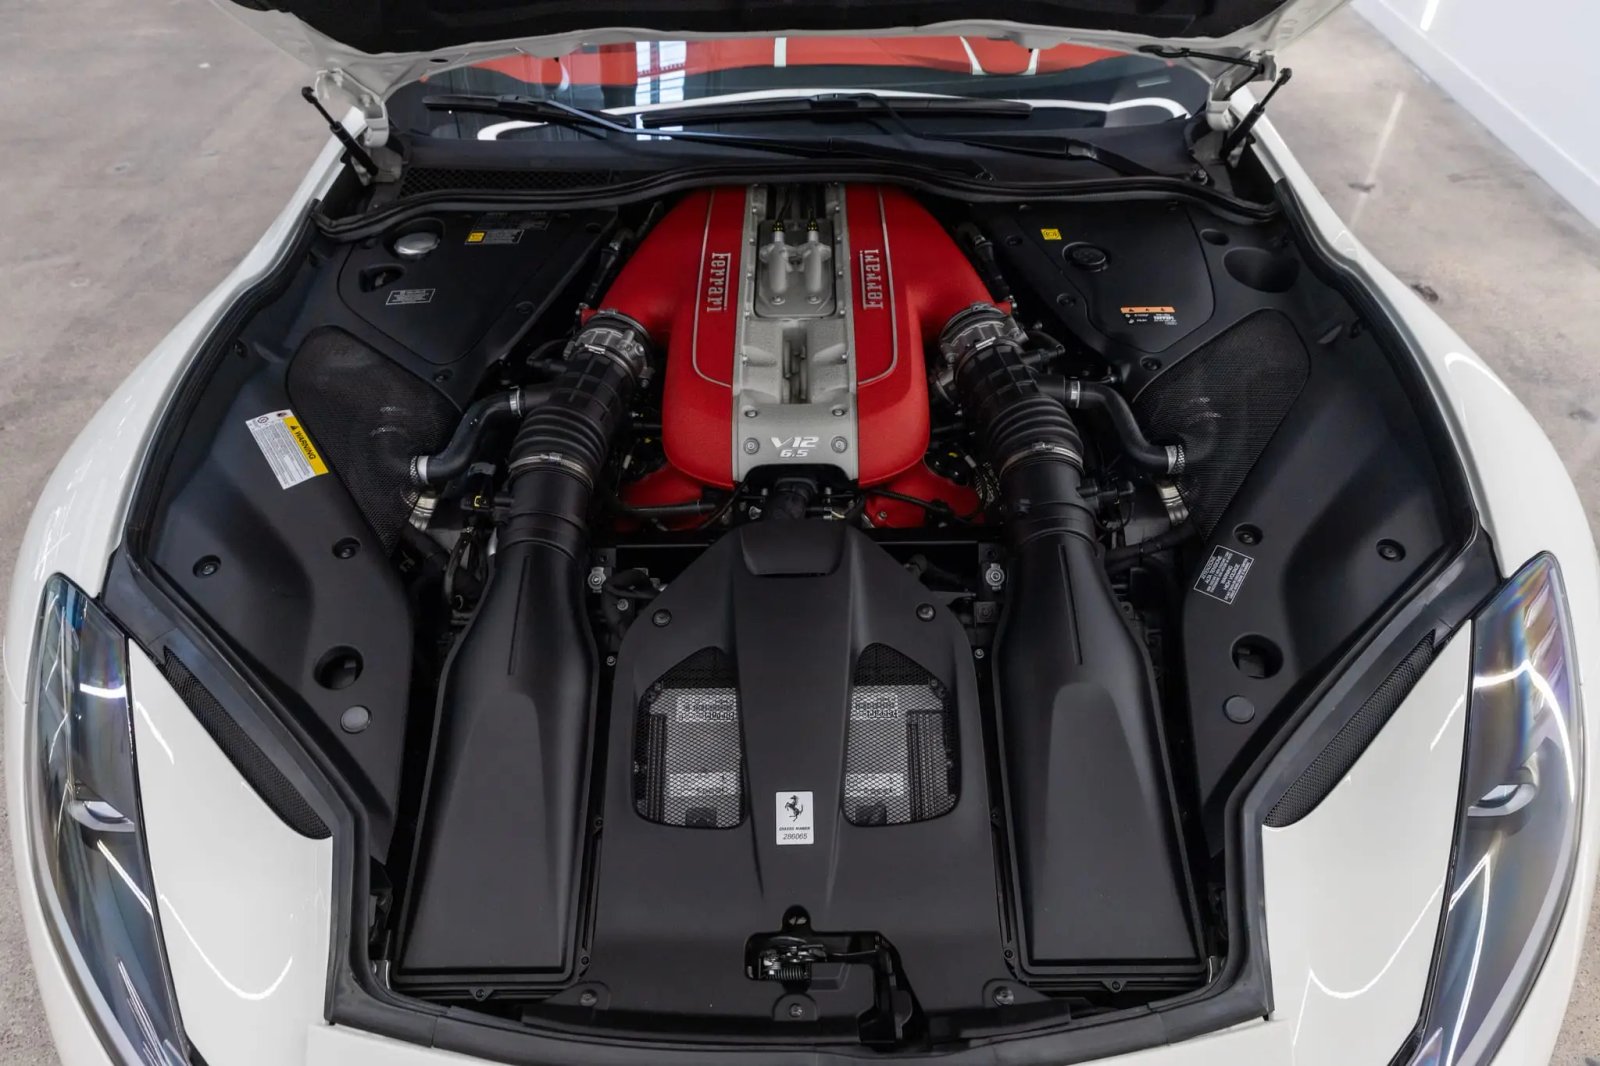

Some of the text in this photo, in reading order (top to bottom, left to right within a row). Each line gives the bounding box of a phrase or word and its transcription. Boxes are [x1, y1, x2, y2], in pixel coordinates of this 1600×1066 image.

[707, 253, 731, 312] Ferrari
[860, 249, 884, 310] Ferrari
[295, 430, 316, 460] WARNING
[771, 436, 820, 448] V12
[780, 449, 808, 457] 6.5
